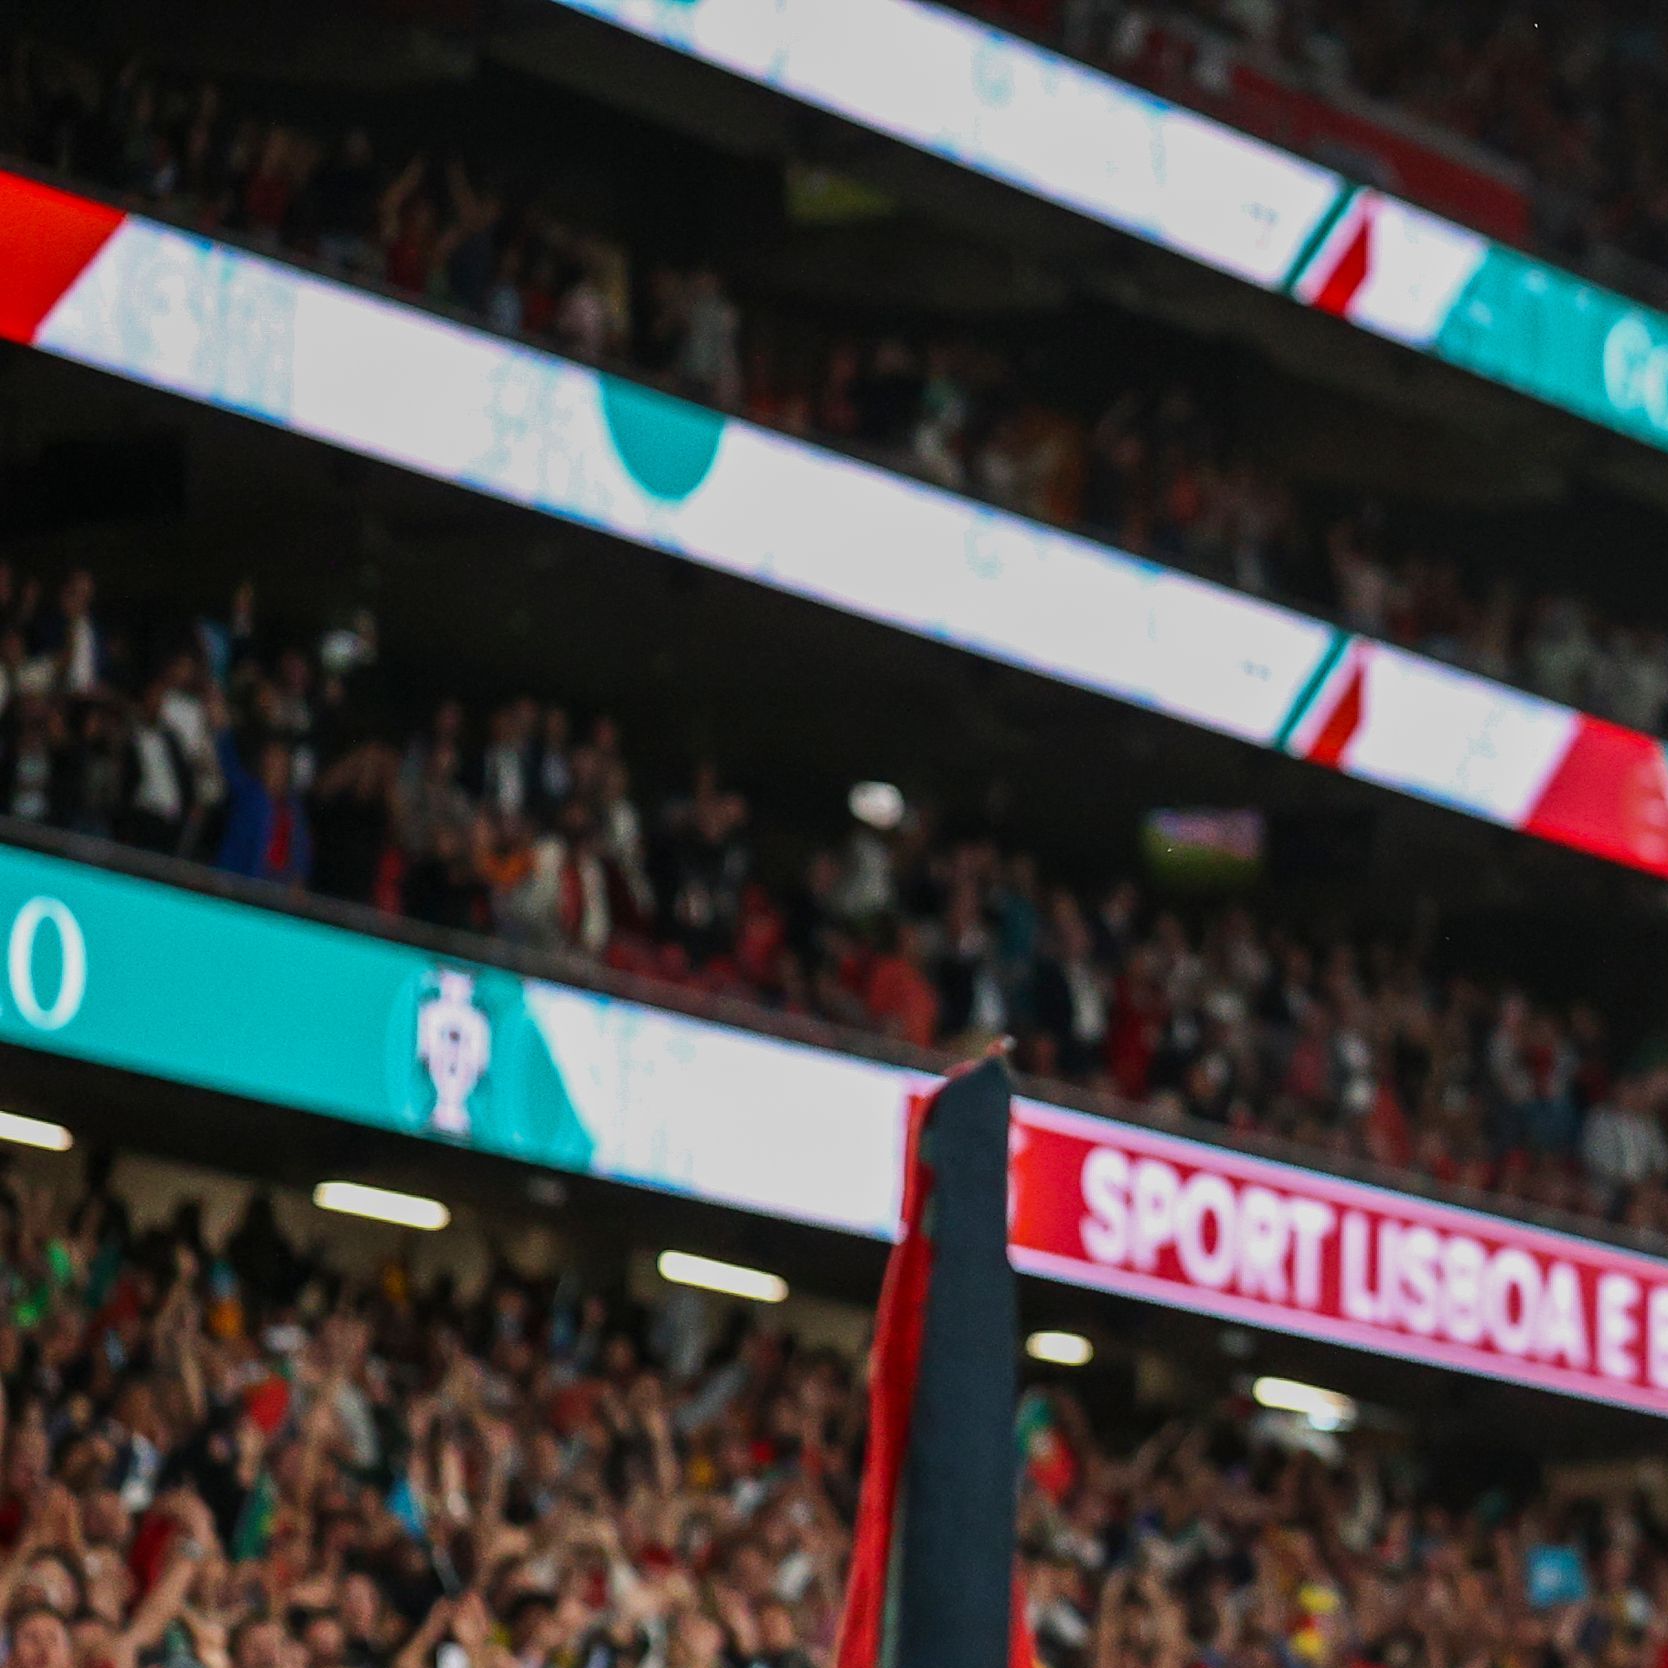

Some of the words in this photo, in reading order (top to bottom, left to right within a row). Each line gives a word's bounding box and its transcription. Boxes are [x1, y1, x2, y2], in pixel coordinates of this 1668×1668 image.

[1080, 1146, 1336, 1310] SPORT
[1339, 1211, 1589, 1369] LISBOA
[1596, 1273, 1640, 1381] E
